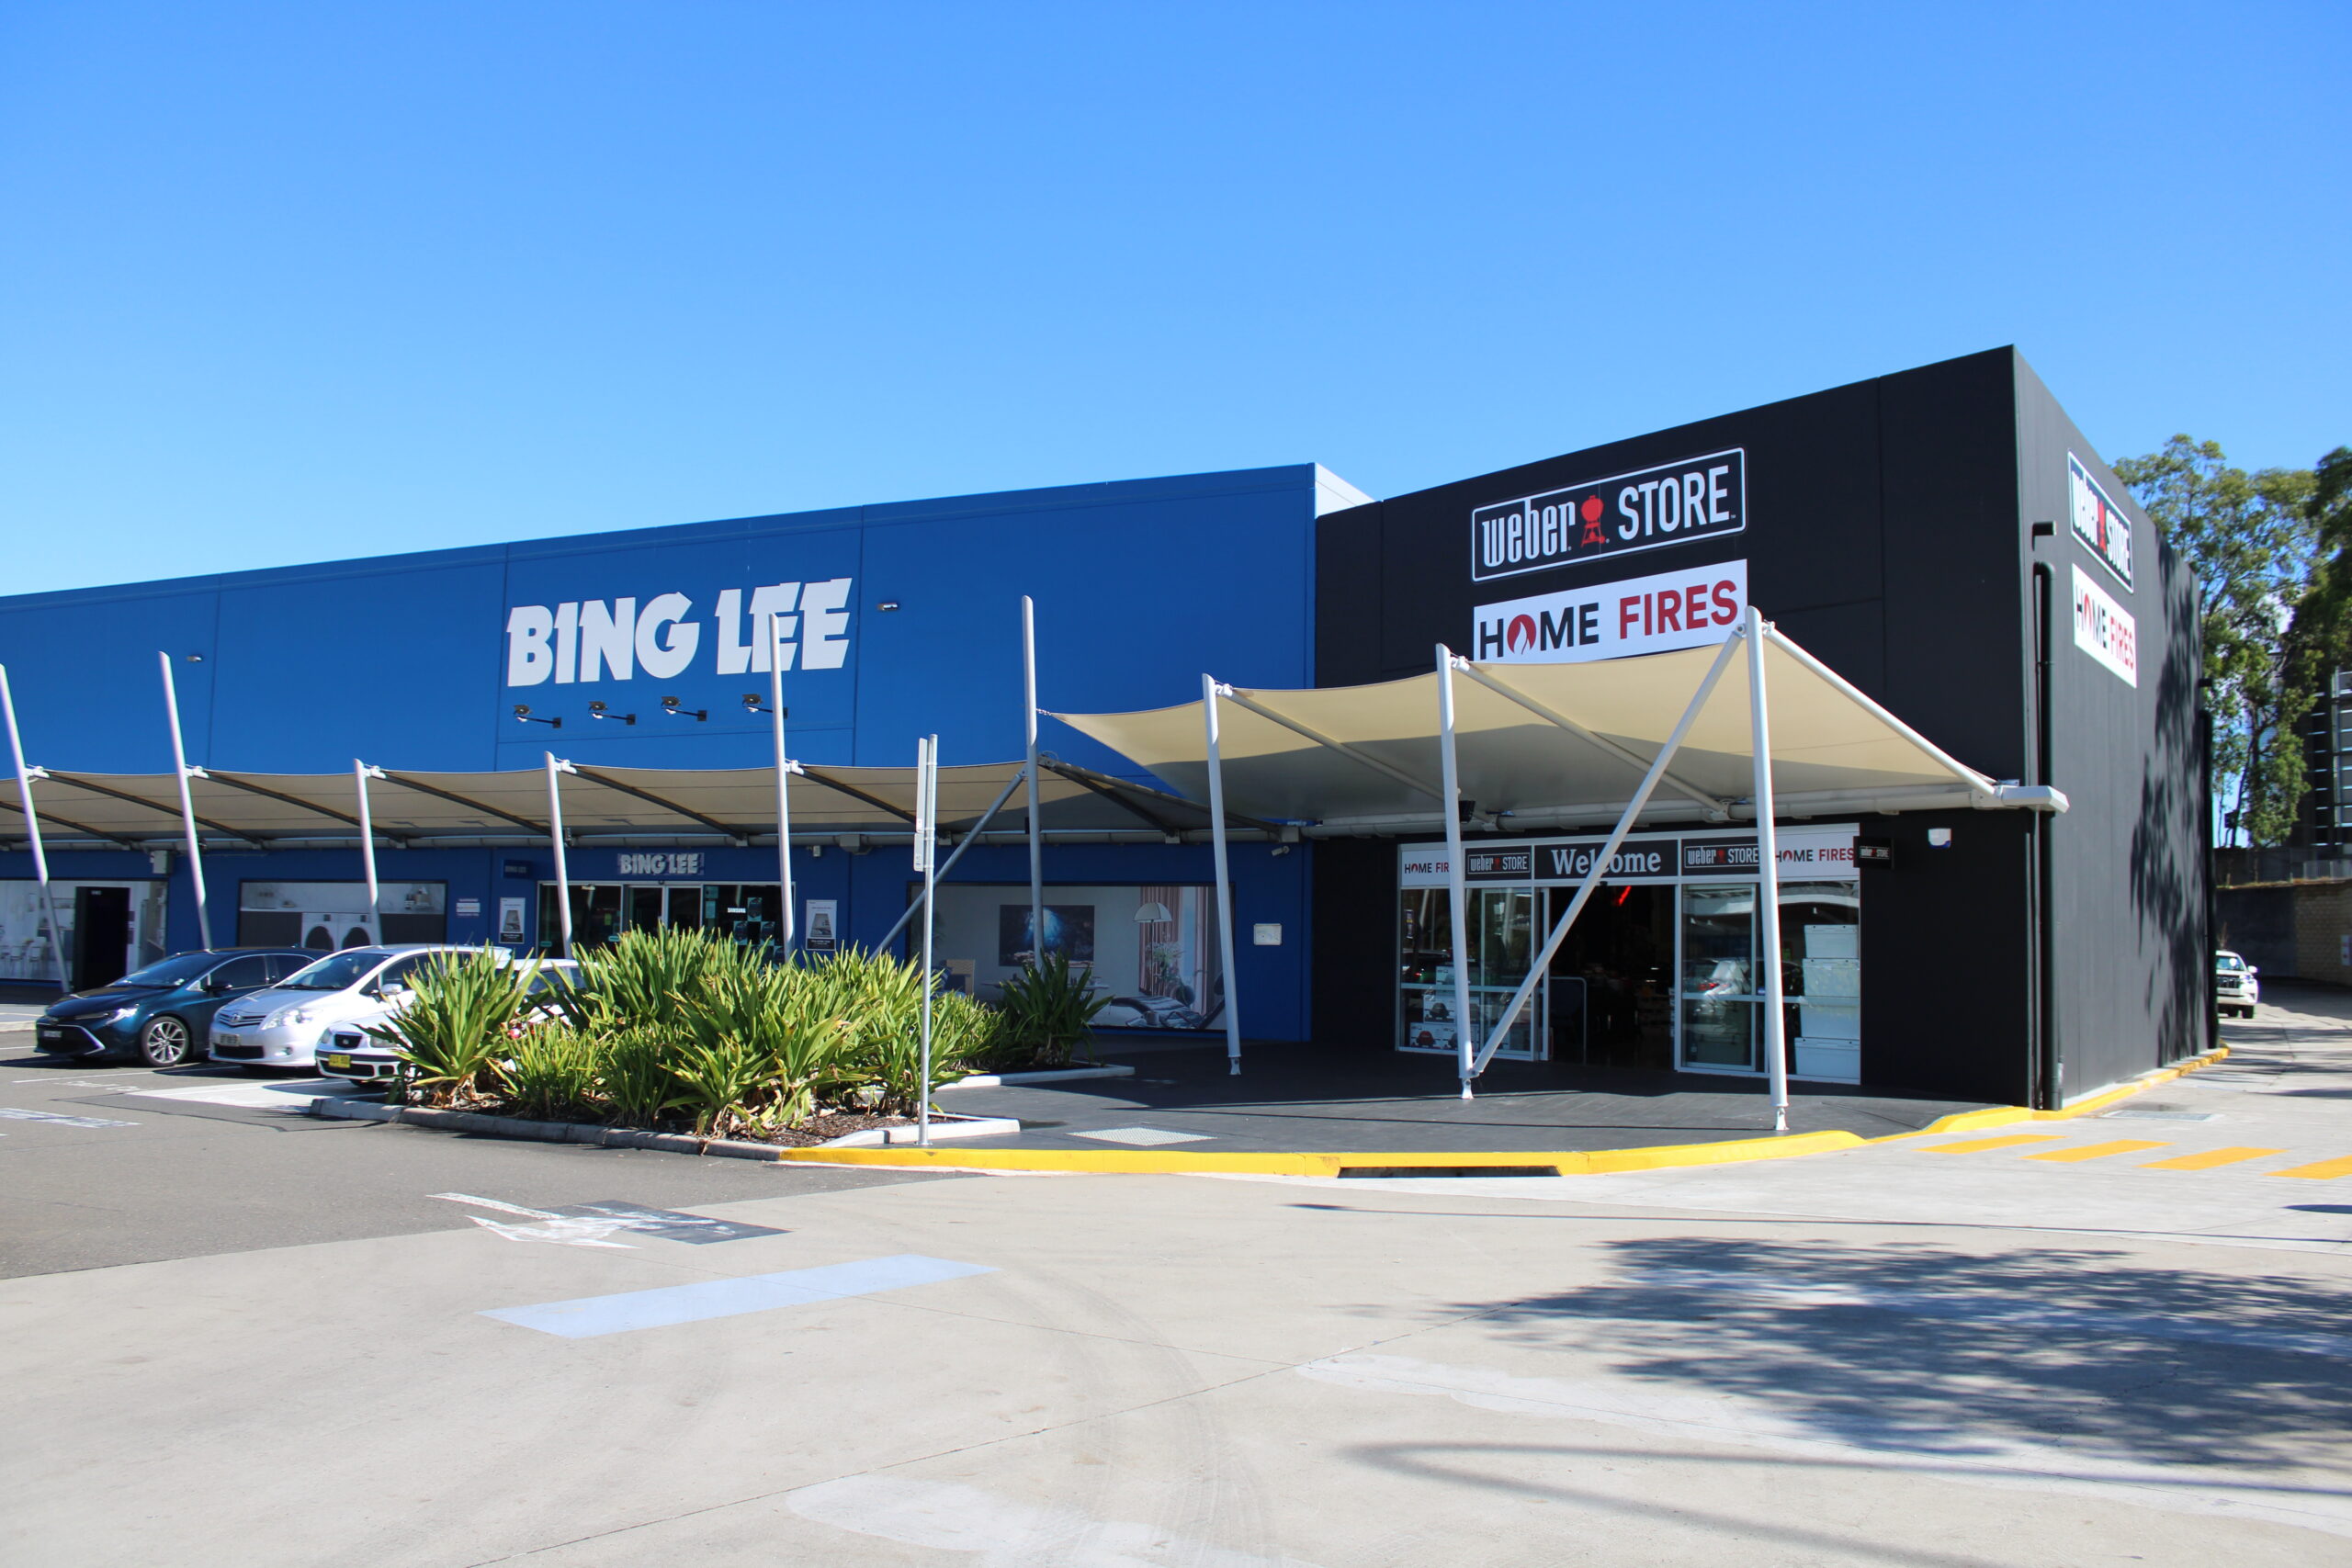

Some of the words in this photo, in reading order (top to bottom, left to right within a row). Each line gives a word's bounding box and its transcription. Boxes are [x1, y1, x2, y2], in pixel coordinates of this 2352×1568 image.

[1482, 497, 1577, 568] weber
[1618, 465, 1731, 540] STORE
[506, 591, 700, 687] BING
[714, 577, 853, 675] LEE
[1480, 602, 1600, 660] HOME
[1619, 580, 1738, 639] FIRES
[2075, 584, 2108, 649] HOME
[2109, 615, 2134, 671] FIRES
[620, 853, 666, 874] BING
[668, 852, 699, 874] LEE
[1469, 854, 1494, 871] weber
[1502, 855, 1528, 871] STORE
[1551, 848, 1661, 874] Welome
[1688, 845, 1716, 865] weber
[1727, 847, 1759, 863] STORE
[1775, 849, 1814, 863] HOME
[1819, 848, 1854, 862] FIRES
[1404, 863, 1432, 874] HOME
